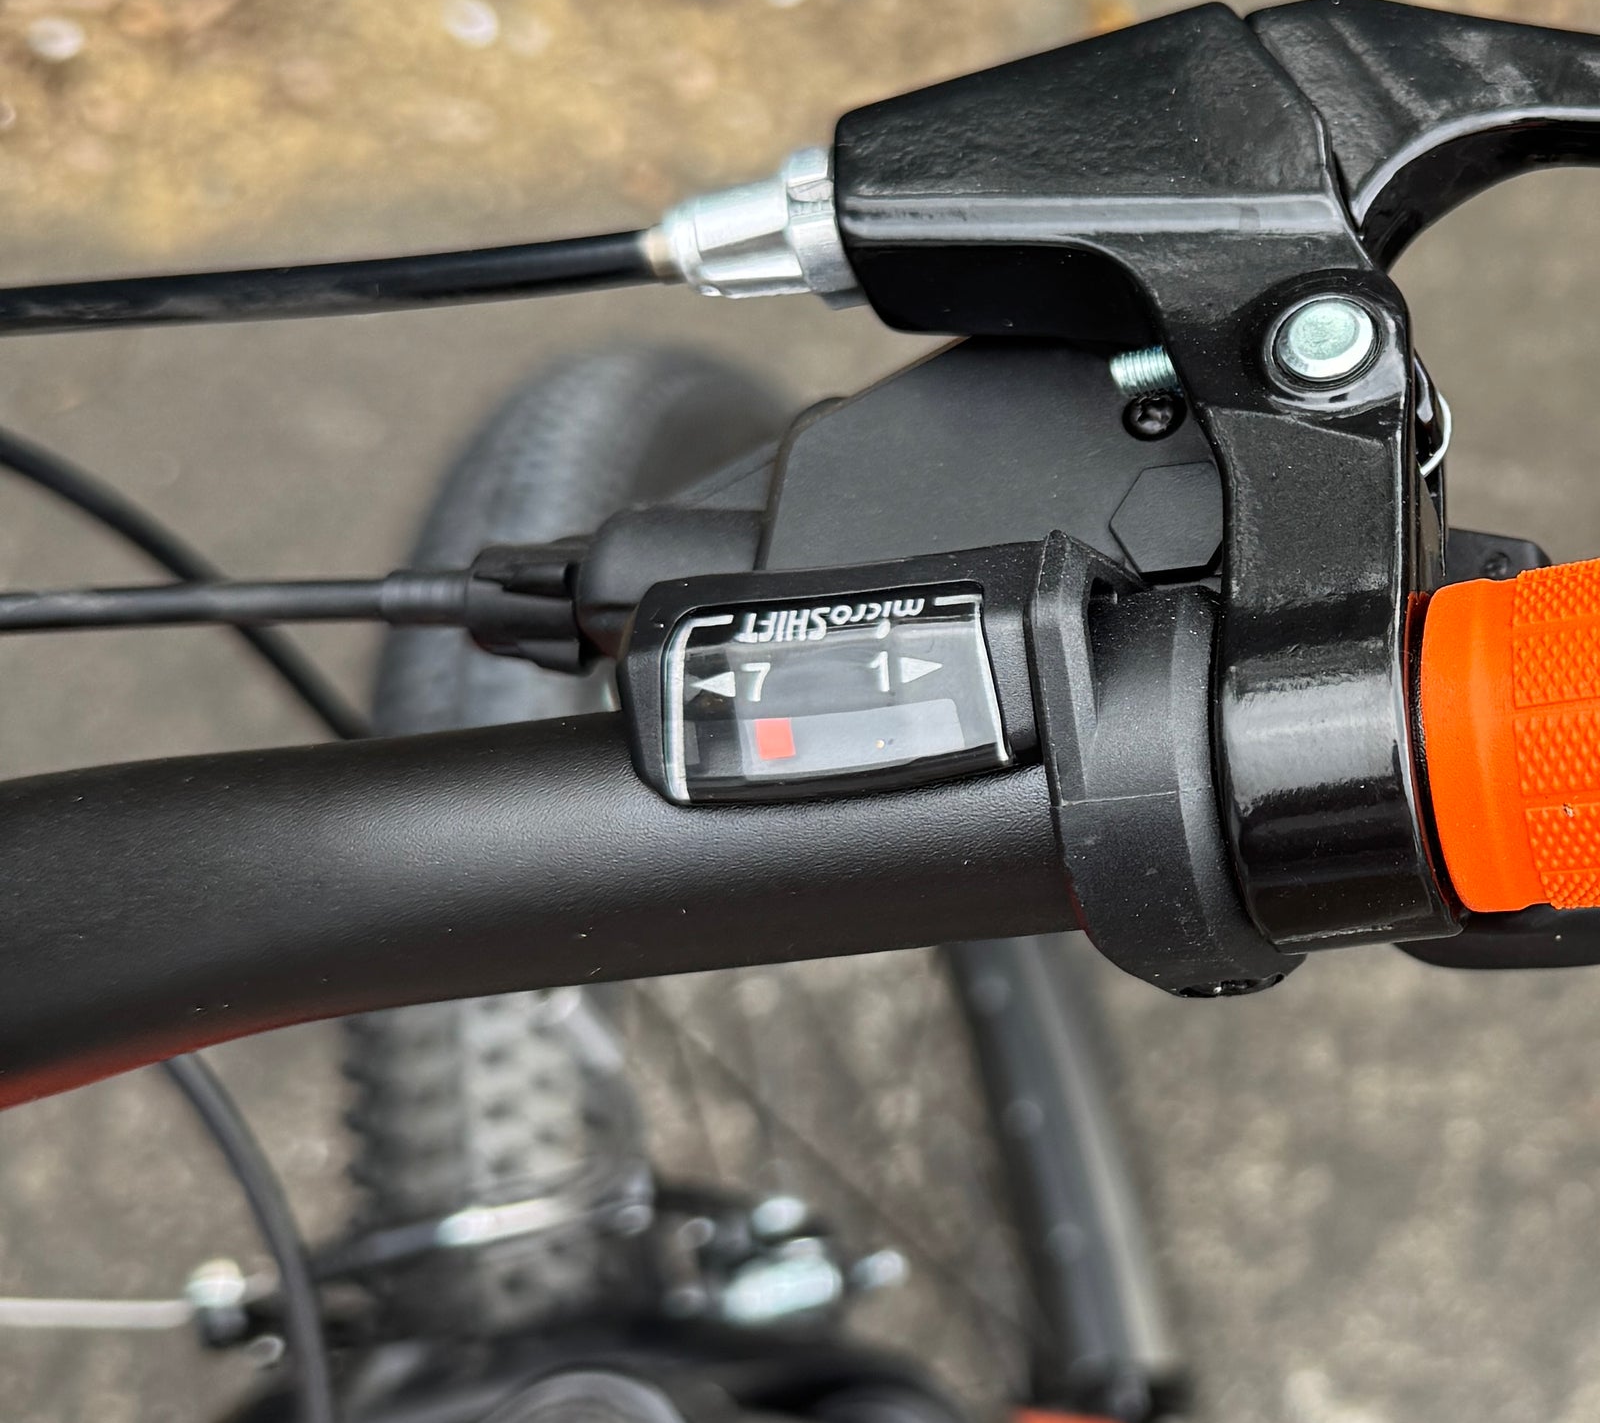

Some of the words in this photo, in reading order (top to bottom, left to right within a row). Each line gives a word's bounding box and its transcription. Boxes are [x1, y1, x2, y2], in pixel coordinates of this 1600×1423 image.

[735, 598, 925, 643] microSHIFT
[742, 662, 772, 703] 7
[870, 650, 891, 692] 1
